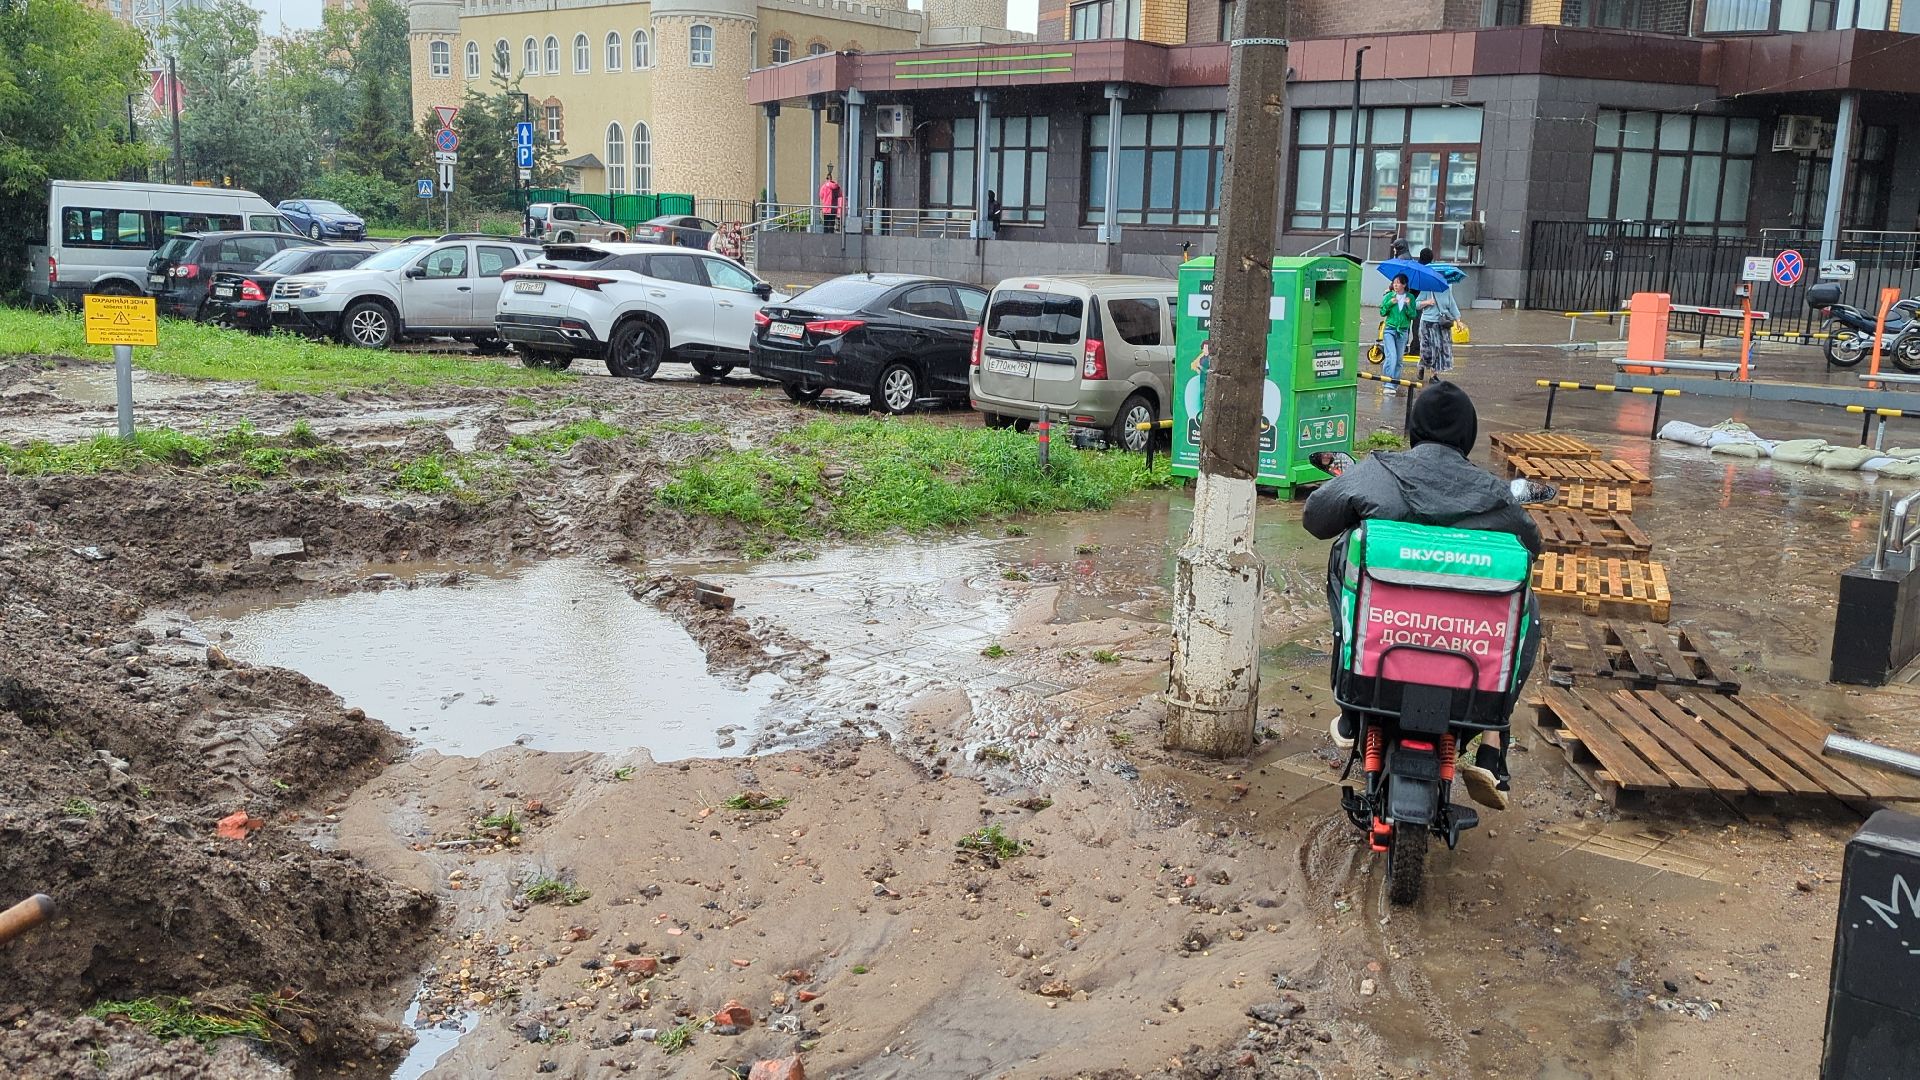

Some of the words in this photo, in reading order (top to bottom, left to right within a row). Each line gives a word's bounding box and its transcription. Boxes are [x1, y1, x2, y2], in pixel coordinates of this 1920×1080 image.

[521, 148, 529, 165] P
[1316, 359, 1341, 368] ОДЕЖДЫ
[1400, 547, 1491, 567] ВКУСВИЛЛ
